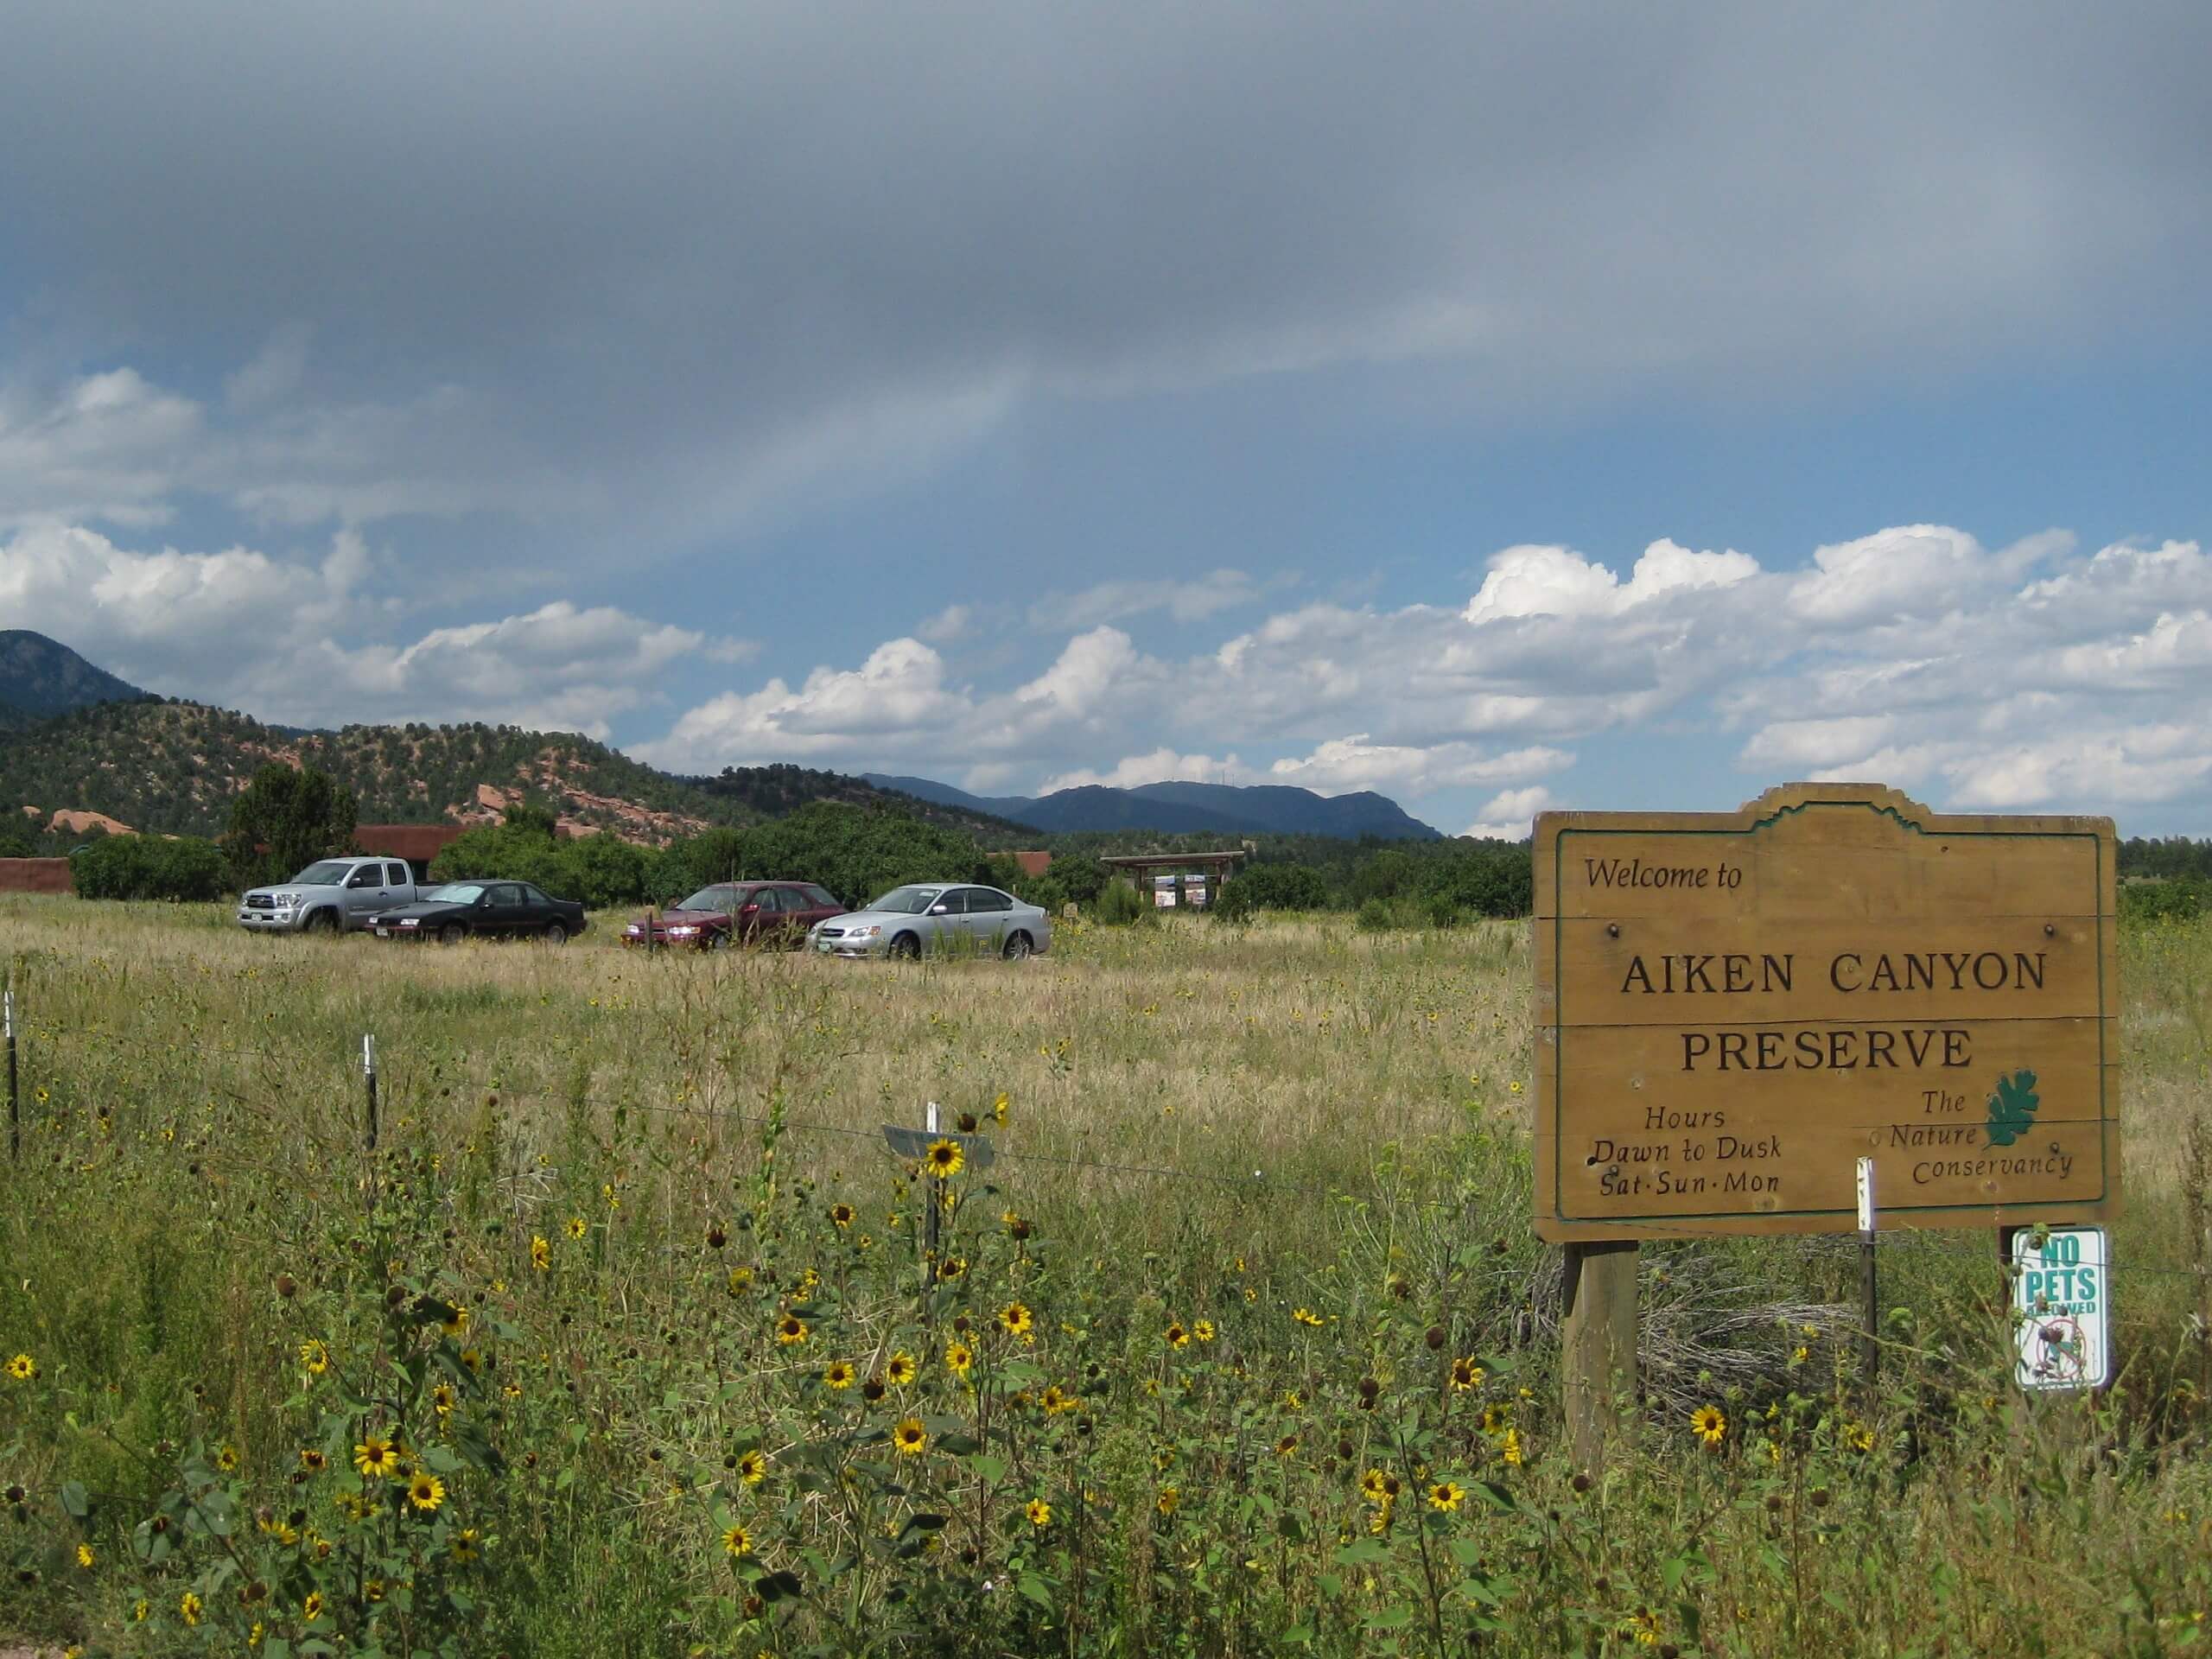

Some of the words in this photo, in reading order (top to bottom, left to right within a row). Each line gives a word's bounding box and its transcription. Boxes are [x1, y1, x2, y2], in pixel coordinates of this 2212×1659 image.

[1585, 857, 1709, 888] Welcome
[1718, 861, 1743, 888] to
[1621, 954, 1795, 994] AIKEN
[1829, 951, 2047, 992] CANYON
[1681, 1029, 1973, 1071] PRESERVE
[1644, 1105, 1726, 1130] Hours
[1922, 1090, 1966, 1114] The
[1594, 1139, 1669, 1164] Dawn
[1682, 1139, 1706, 1162] to
[1716, 1135, 1782, 1160] Dusk
[1891, 1123, 1978, 1148] Nature
[1912, 1154, 2073, 1185] Conservancy
[2041, 1235, 2081, 1269] NO
[2025, 1267, 2096, 1304] PETS
